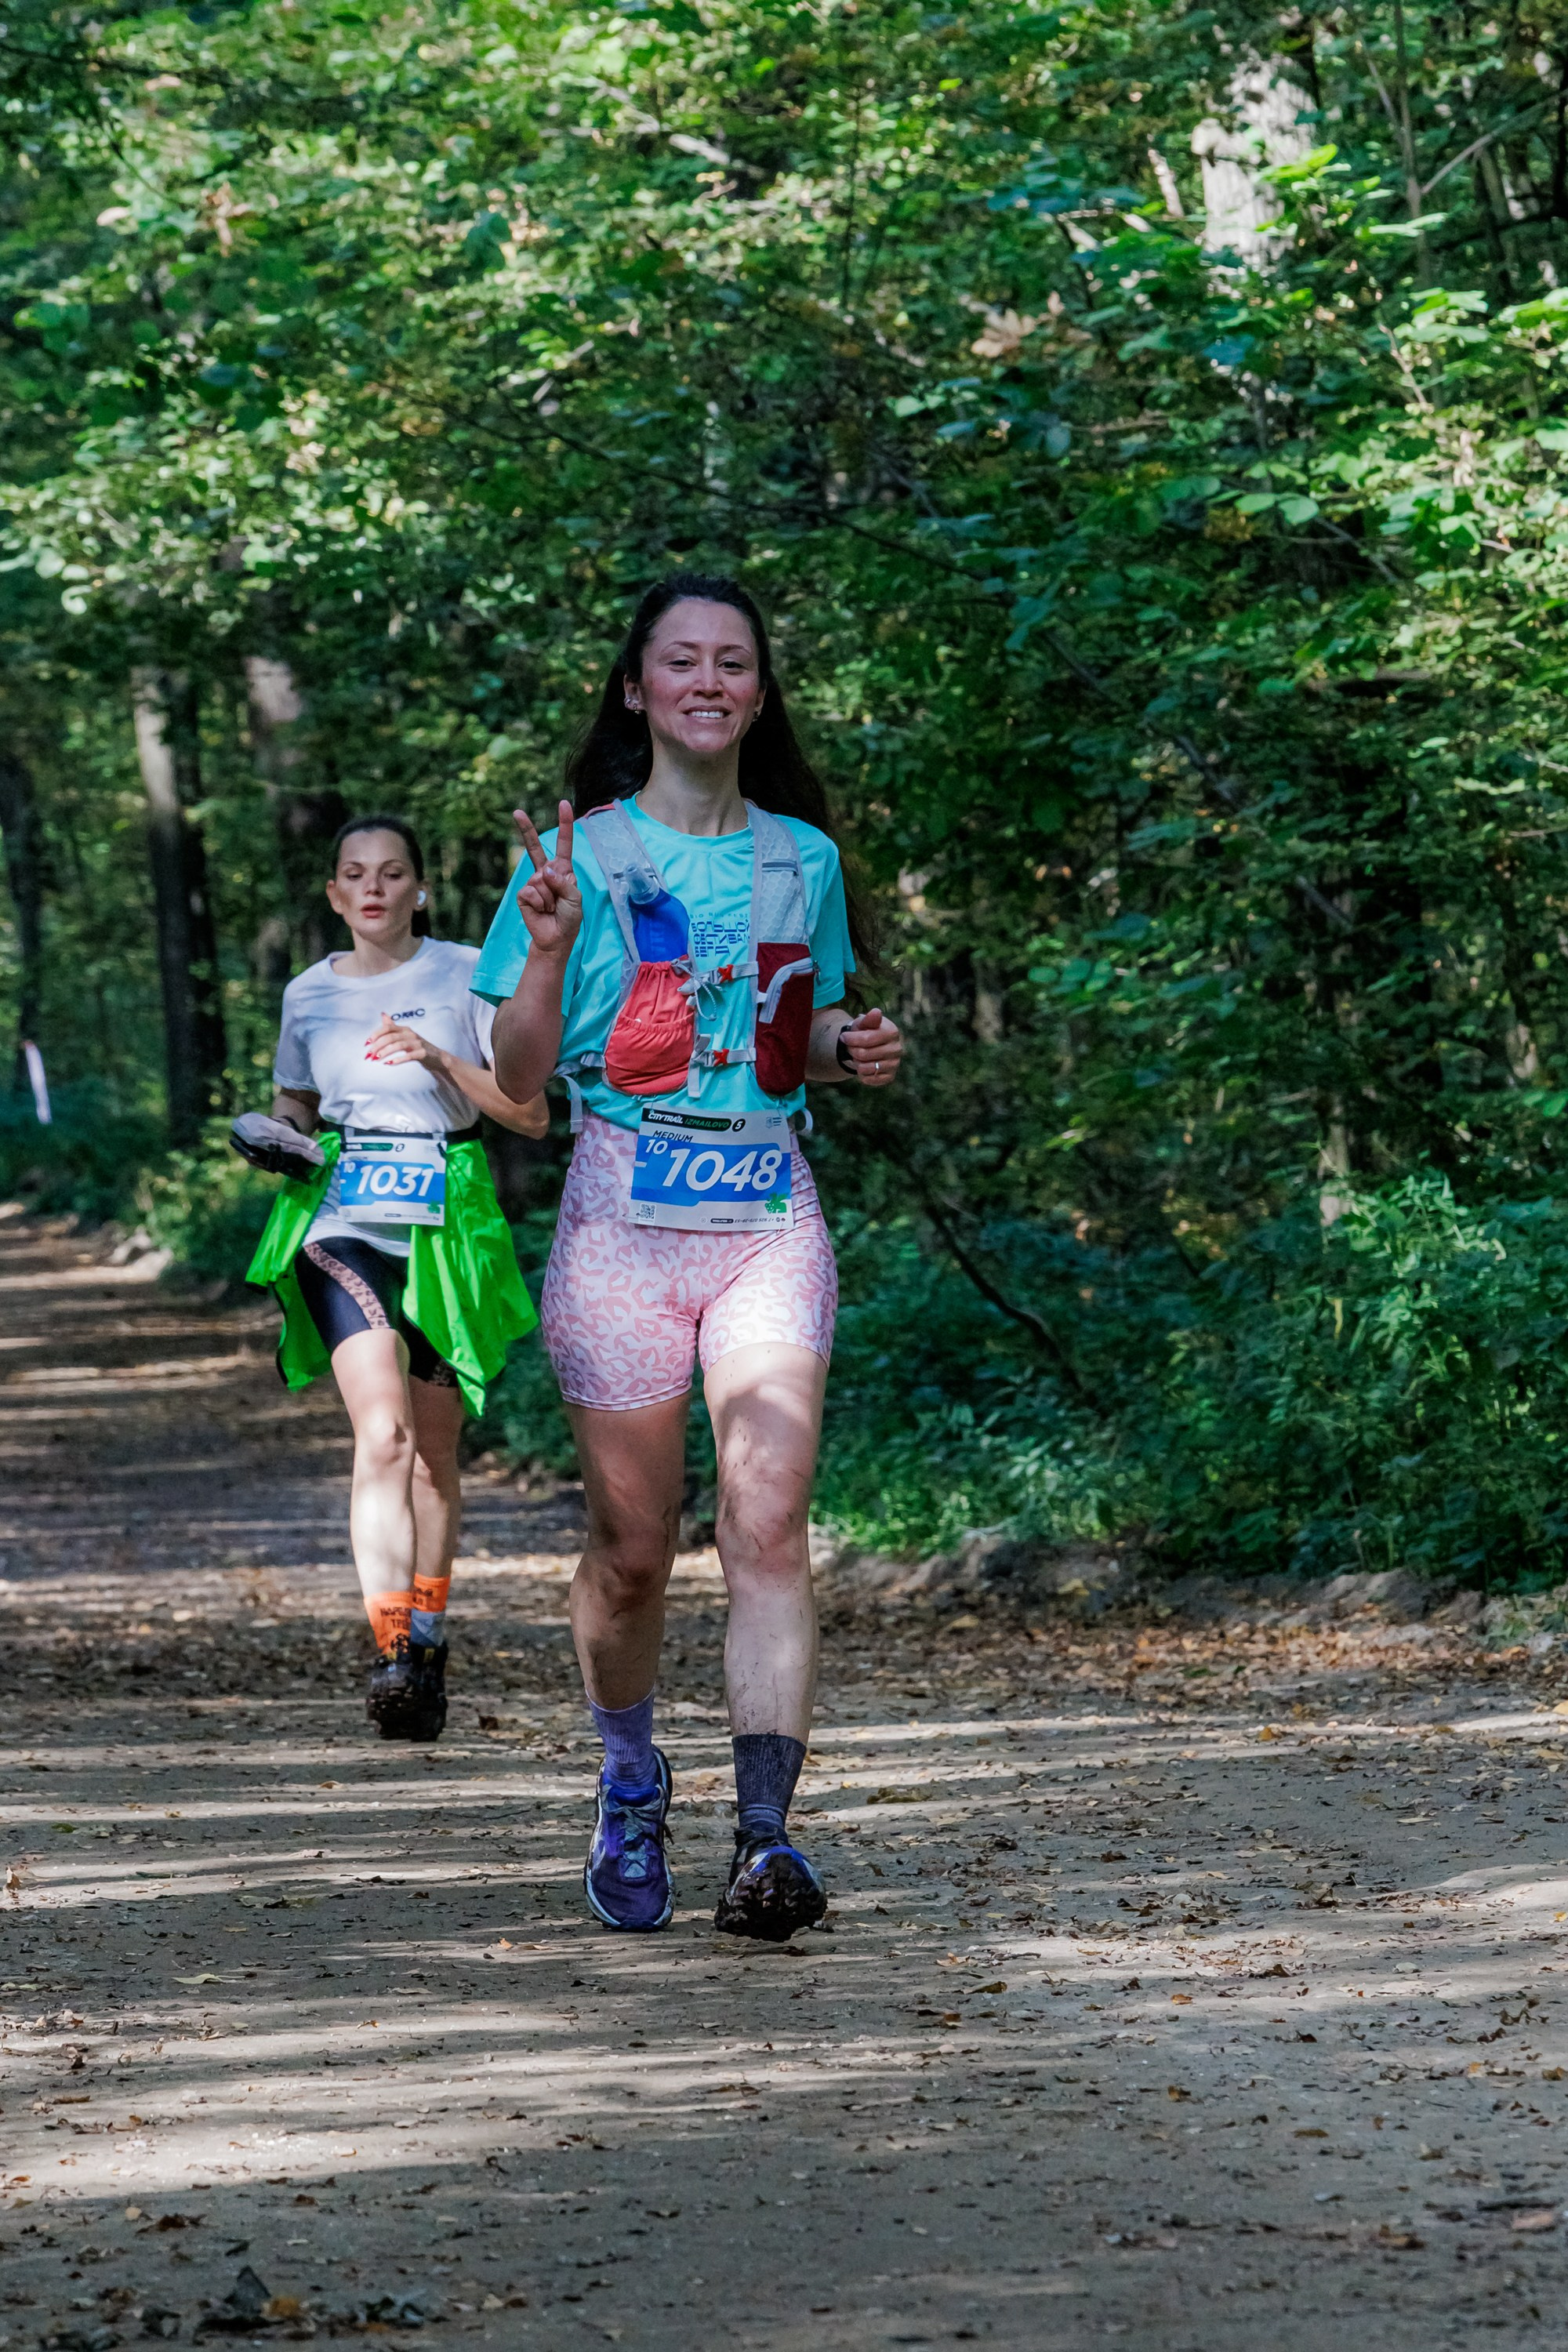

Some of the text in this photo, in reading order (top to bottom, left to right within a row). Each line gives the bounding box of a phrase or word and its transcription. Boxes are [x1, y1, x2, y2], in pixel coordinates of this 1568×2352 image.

[684, 1117, 730, 1129] IZMAILOVO
[735, 1120, 744, 1130] 5
[652, 1130, 694, 1143] MEDIUM
[645, 1139, 669, 1155] 10
[662, 1148, 783, 1192] 1048
[357, 1164, 435, 1197] 1031
